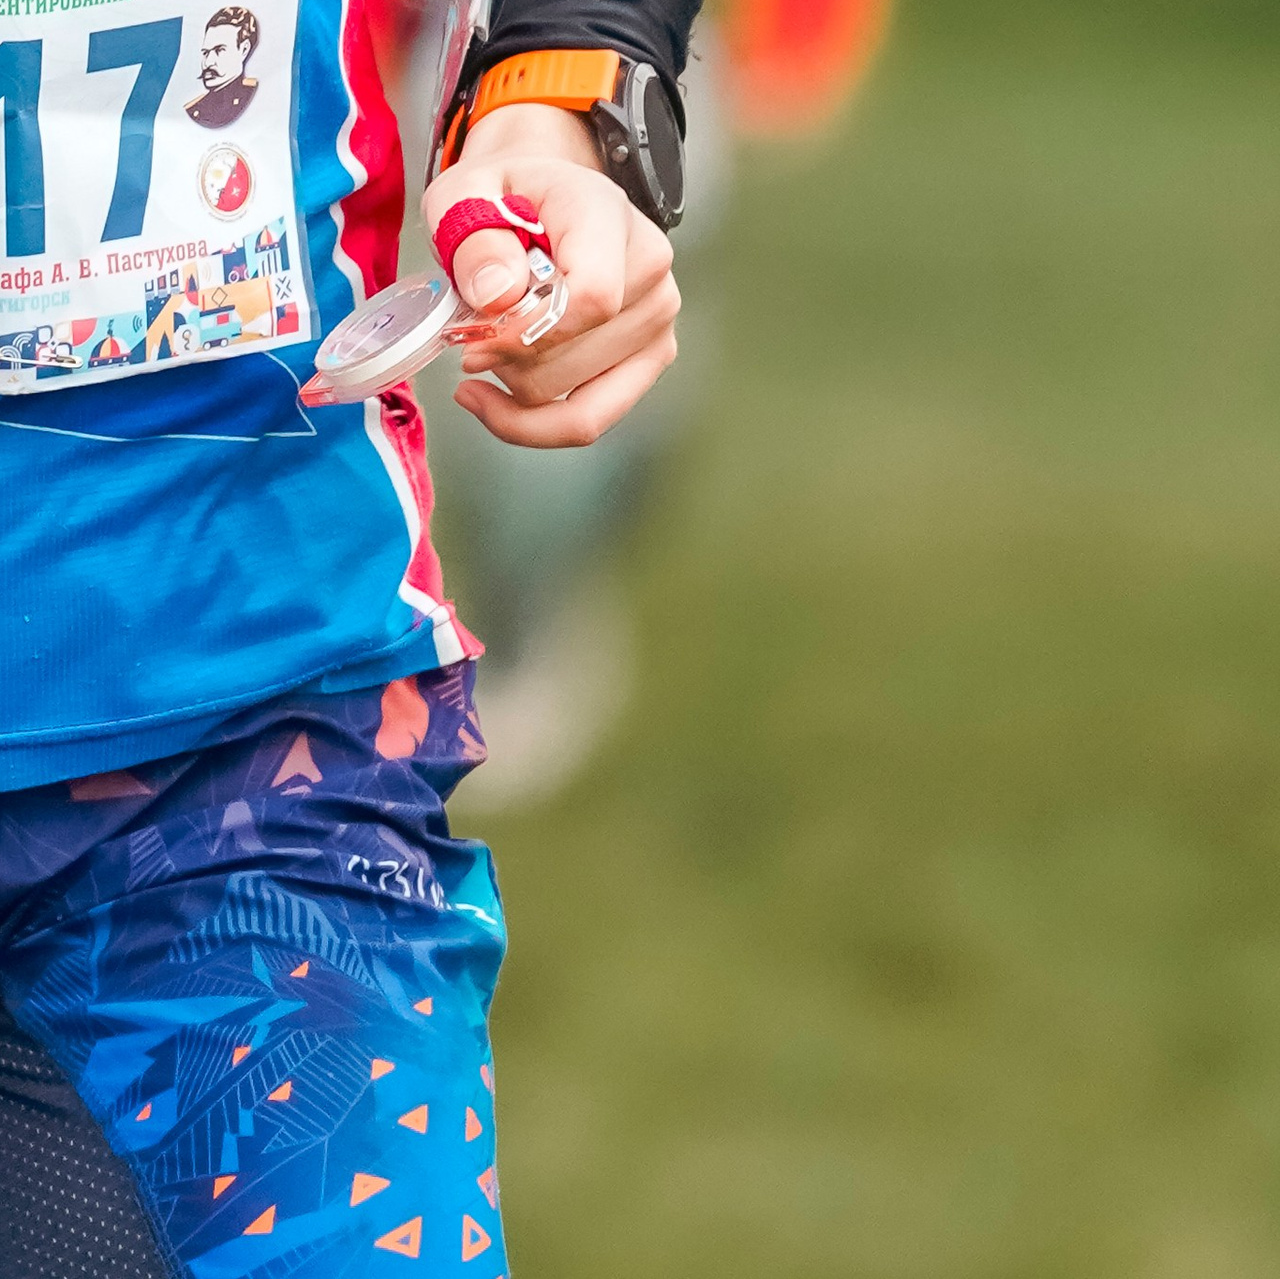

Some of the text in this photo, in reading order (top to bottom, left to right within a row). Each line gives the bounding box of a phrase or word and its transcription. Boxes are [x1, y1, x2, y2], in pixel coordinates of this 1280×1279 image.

[51, 262, 70, 285] А.
[78, 258, 99, 279] В.
[107, 239, 209, 275] Пастухова
